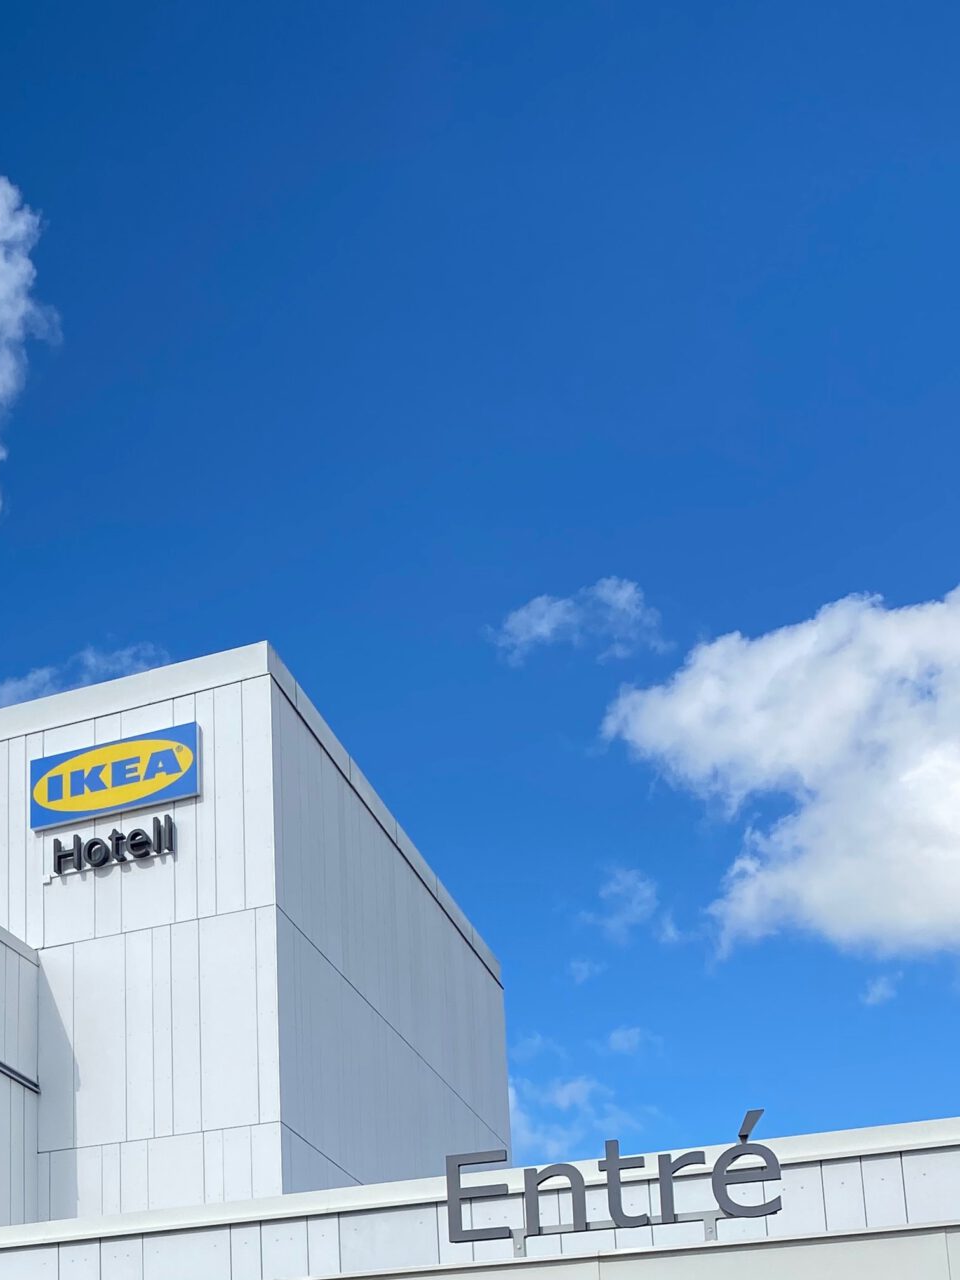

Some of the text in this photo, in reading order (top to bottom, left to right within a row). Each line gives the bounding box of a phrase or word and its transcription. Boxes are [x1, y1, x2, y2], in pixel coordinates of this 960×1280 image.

[47, 748, 183, 803] IKEA
[53, 814, 175, 875] Hotell
[445, 1109, 783, 1243] Entré
